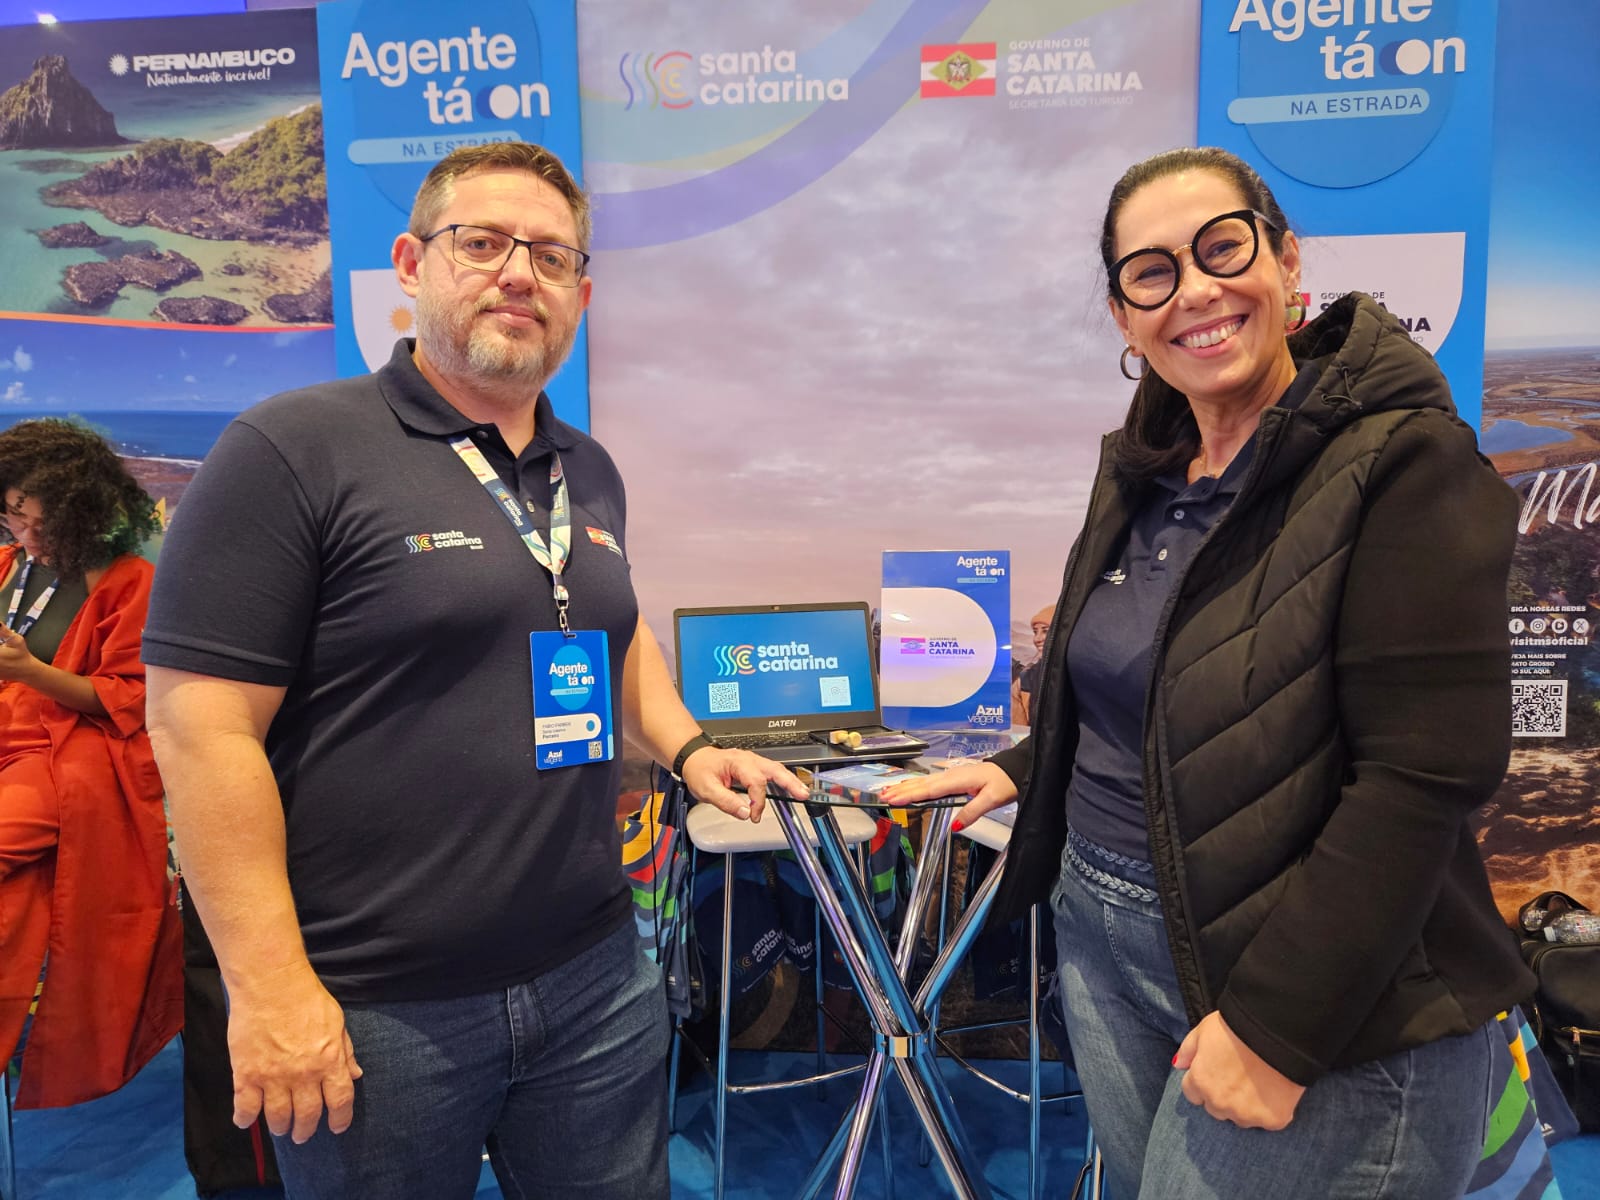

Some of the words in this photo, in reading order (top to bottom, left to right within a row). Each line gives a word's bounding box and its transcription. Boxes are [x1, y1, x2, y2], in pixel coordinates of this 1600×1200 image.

[1008, 39, 1071, 51] GOVERNO
[1073, 38, 1090, 48] DE
[133, 47, 296, 73] PERNAMBUCO
[341, 26, 517, 88] Agente
[699, 45, 797, 76] santa
[1007, 51, 1097, 73] SANTA
[1320, 30, 1375, 80] tá
[1395, 37, 1466, 75] on
[146, 70, 223, 88] Naturalmente
[1006, 71, 1144, 96] CATARINA
[700, 74, 849, 105] catarina
[422, 76, 474, 124] tá
[488, 82, 551, 119] on
[1290, 101, 1318, 115] NA
[1326, 94, 1423, 114] ESTRADA
[402, 143, 427, 157] NA
[431, 530, 465, 541] santa
[434, 537, 483, 549] catarina
[956, 555, 998, 569] Agente
[757, 641, 811, 658] santa
[549, 662, 588, 678] Agente
[758, 655, 839, 673] catarina
[567, 673, 579, 686] tá
[581, 675, 595, 685] on
[975, 704, 1004, 716] Azul
[768, 719, 797, 728] DATEN
[967, 715, 1004, 726] viagens
[751, 928, 776, 957] santa
